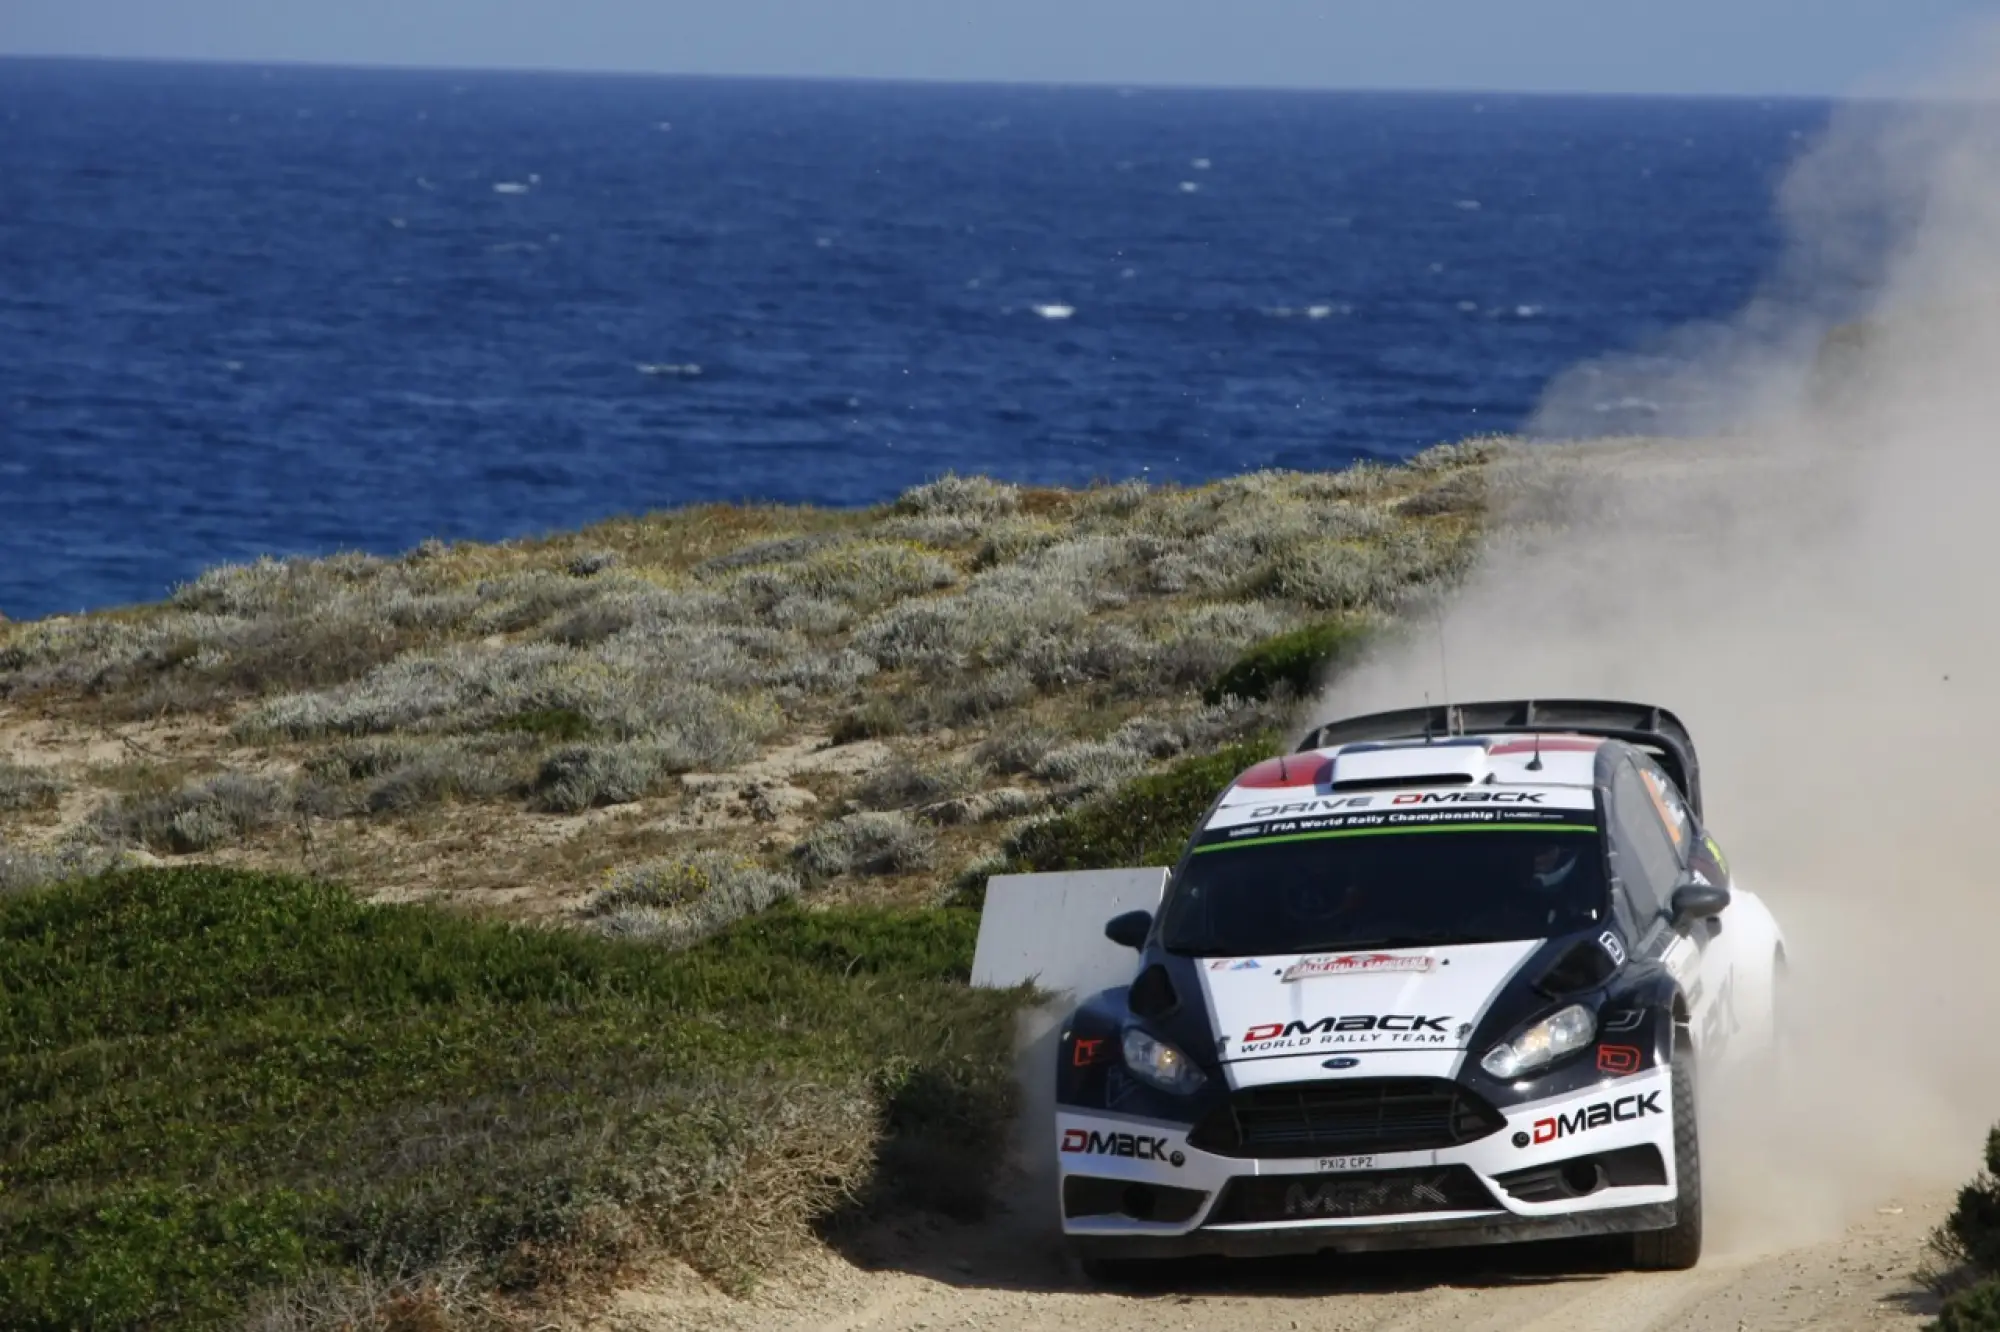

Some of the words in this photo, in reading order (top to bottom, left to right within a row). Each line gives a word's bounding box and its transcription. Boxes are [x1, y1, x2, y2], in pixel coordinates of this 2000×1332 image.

[1250, 796, 1374, 819] DRIVE
[1271, 822, 1297, 833] FIA
[1300, 816, 1344, 829] World
[1347, 813, 1384, 826] Rally
[1388, 809, 1494, 823] Championship
[1241, 1036, 1312, 1053] WORLD
[1319, 1033, 1382, 1045] RALLY
[1391, 1031, 1446, 1043] TEAM
[1319, 1158, 1347, 1170] PX12
[1349, 1156, 1373, 1168] CPZ
